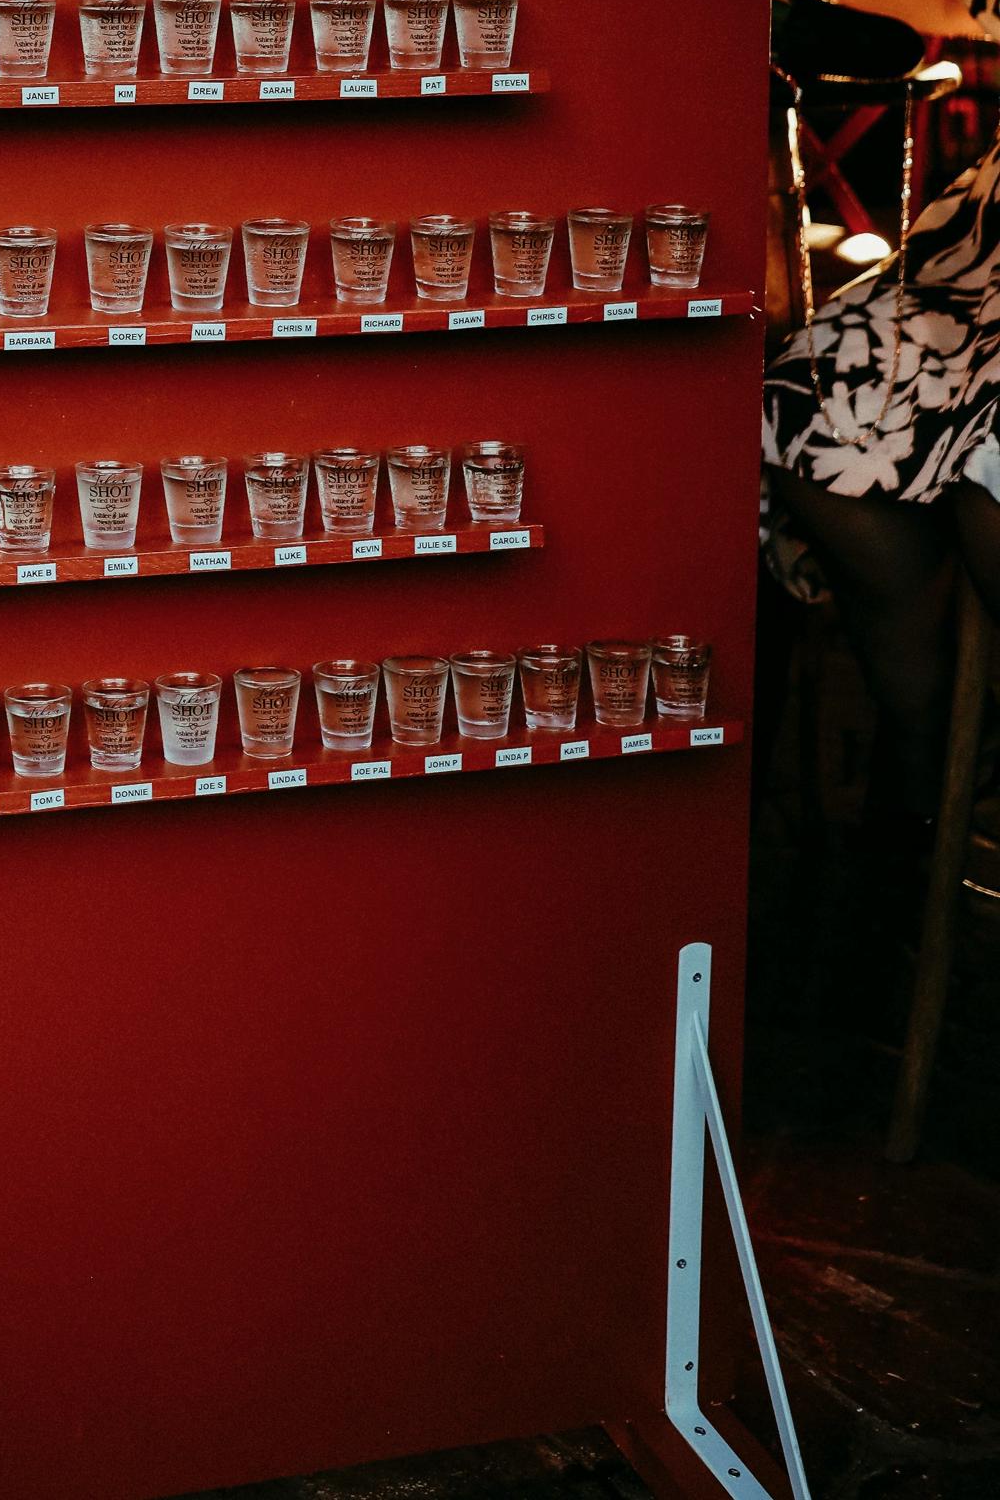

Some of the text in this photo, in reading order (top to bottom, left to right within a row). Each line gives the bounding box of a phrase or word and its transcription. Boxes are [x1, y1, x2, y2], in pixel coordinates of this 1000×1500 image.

[175, 11, 212, 23] SHOT
[425, 81, 442, 90] PAT
[494, 79, 527, 87] STEVEN
[118, 90, 134, 98] KIM
[192, 87, 219, 96] DREW
[262, 86, 292, 95] SARAH
[343, 85, 375, 93] LAURIE
[26, 91, 56, 101] JANET
[181, 251, 222, 263] SHOT
[607, 307, 634, 317] SUSAN
[690, 304, 719, 313] RONNIE
[452, 315, 482, 325] SHAWN
[530, 313, 556, 322] CHRIS
[277, 324, 303, 333] CHRIS
[364, 319, 401, 328] RICHARD
[111, 333, 144, 341] COREY
[194, 328, 223, 337] NUALA
[8, 337, 52, 346] BARBARA
[328, 471, 368, 484] SHOT
[89, 485, 131, 497] SHOT
[417, 540, 453, 550] JULIE SE
[492, 536, 520, 545] CAROL
[355, 544, 380, 554] KEVIN
[278, 551, 302, 561] LUKE
[193, 557, 228, 566] NATHAN
[107, 562, 134, 572] EMILY
[20, 569, 44, 579] JAKE
[403, 685, 441, 698] SHOT
[253, 696, 292, 709] SHOT
[172, 703, 212, 716] SHOT
[694, 733, 713, 741] NICK
[624, 738, 650, 749] JAMES
[563, 746, 586, 756] KATIE
[498, 753, 522, 762] LINDA
[427, 760, 451, 769] JOHN
[354, 766, 389, 776] JOE PAL
[271, 775, 297, 785] LINDA
[198, 782, 216, 791] JOE
[115, 788, 149, 799] DONNIE
[33, 796, 53, 806] TOM
